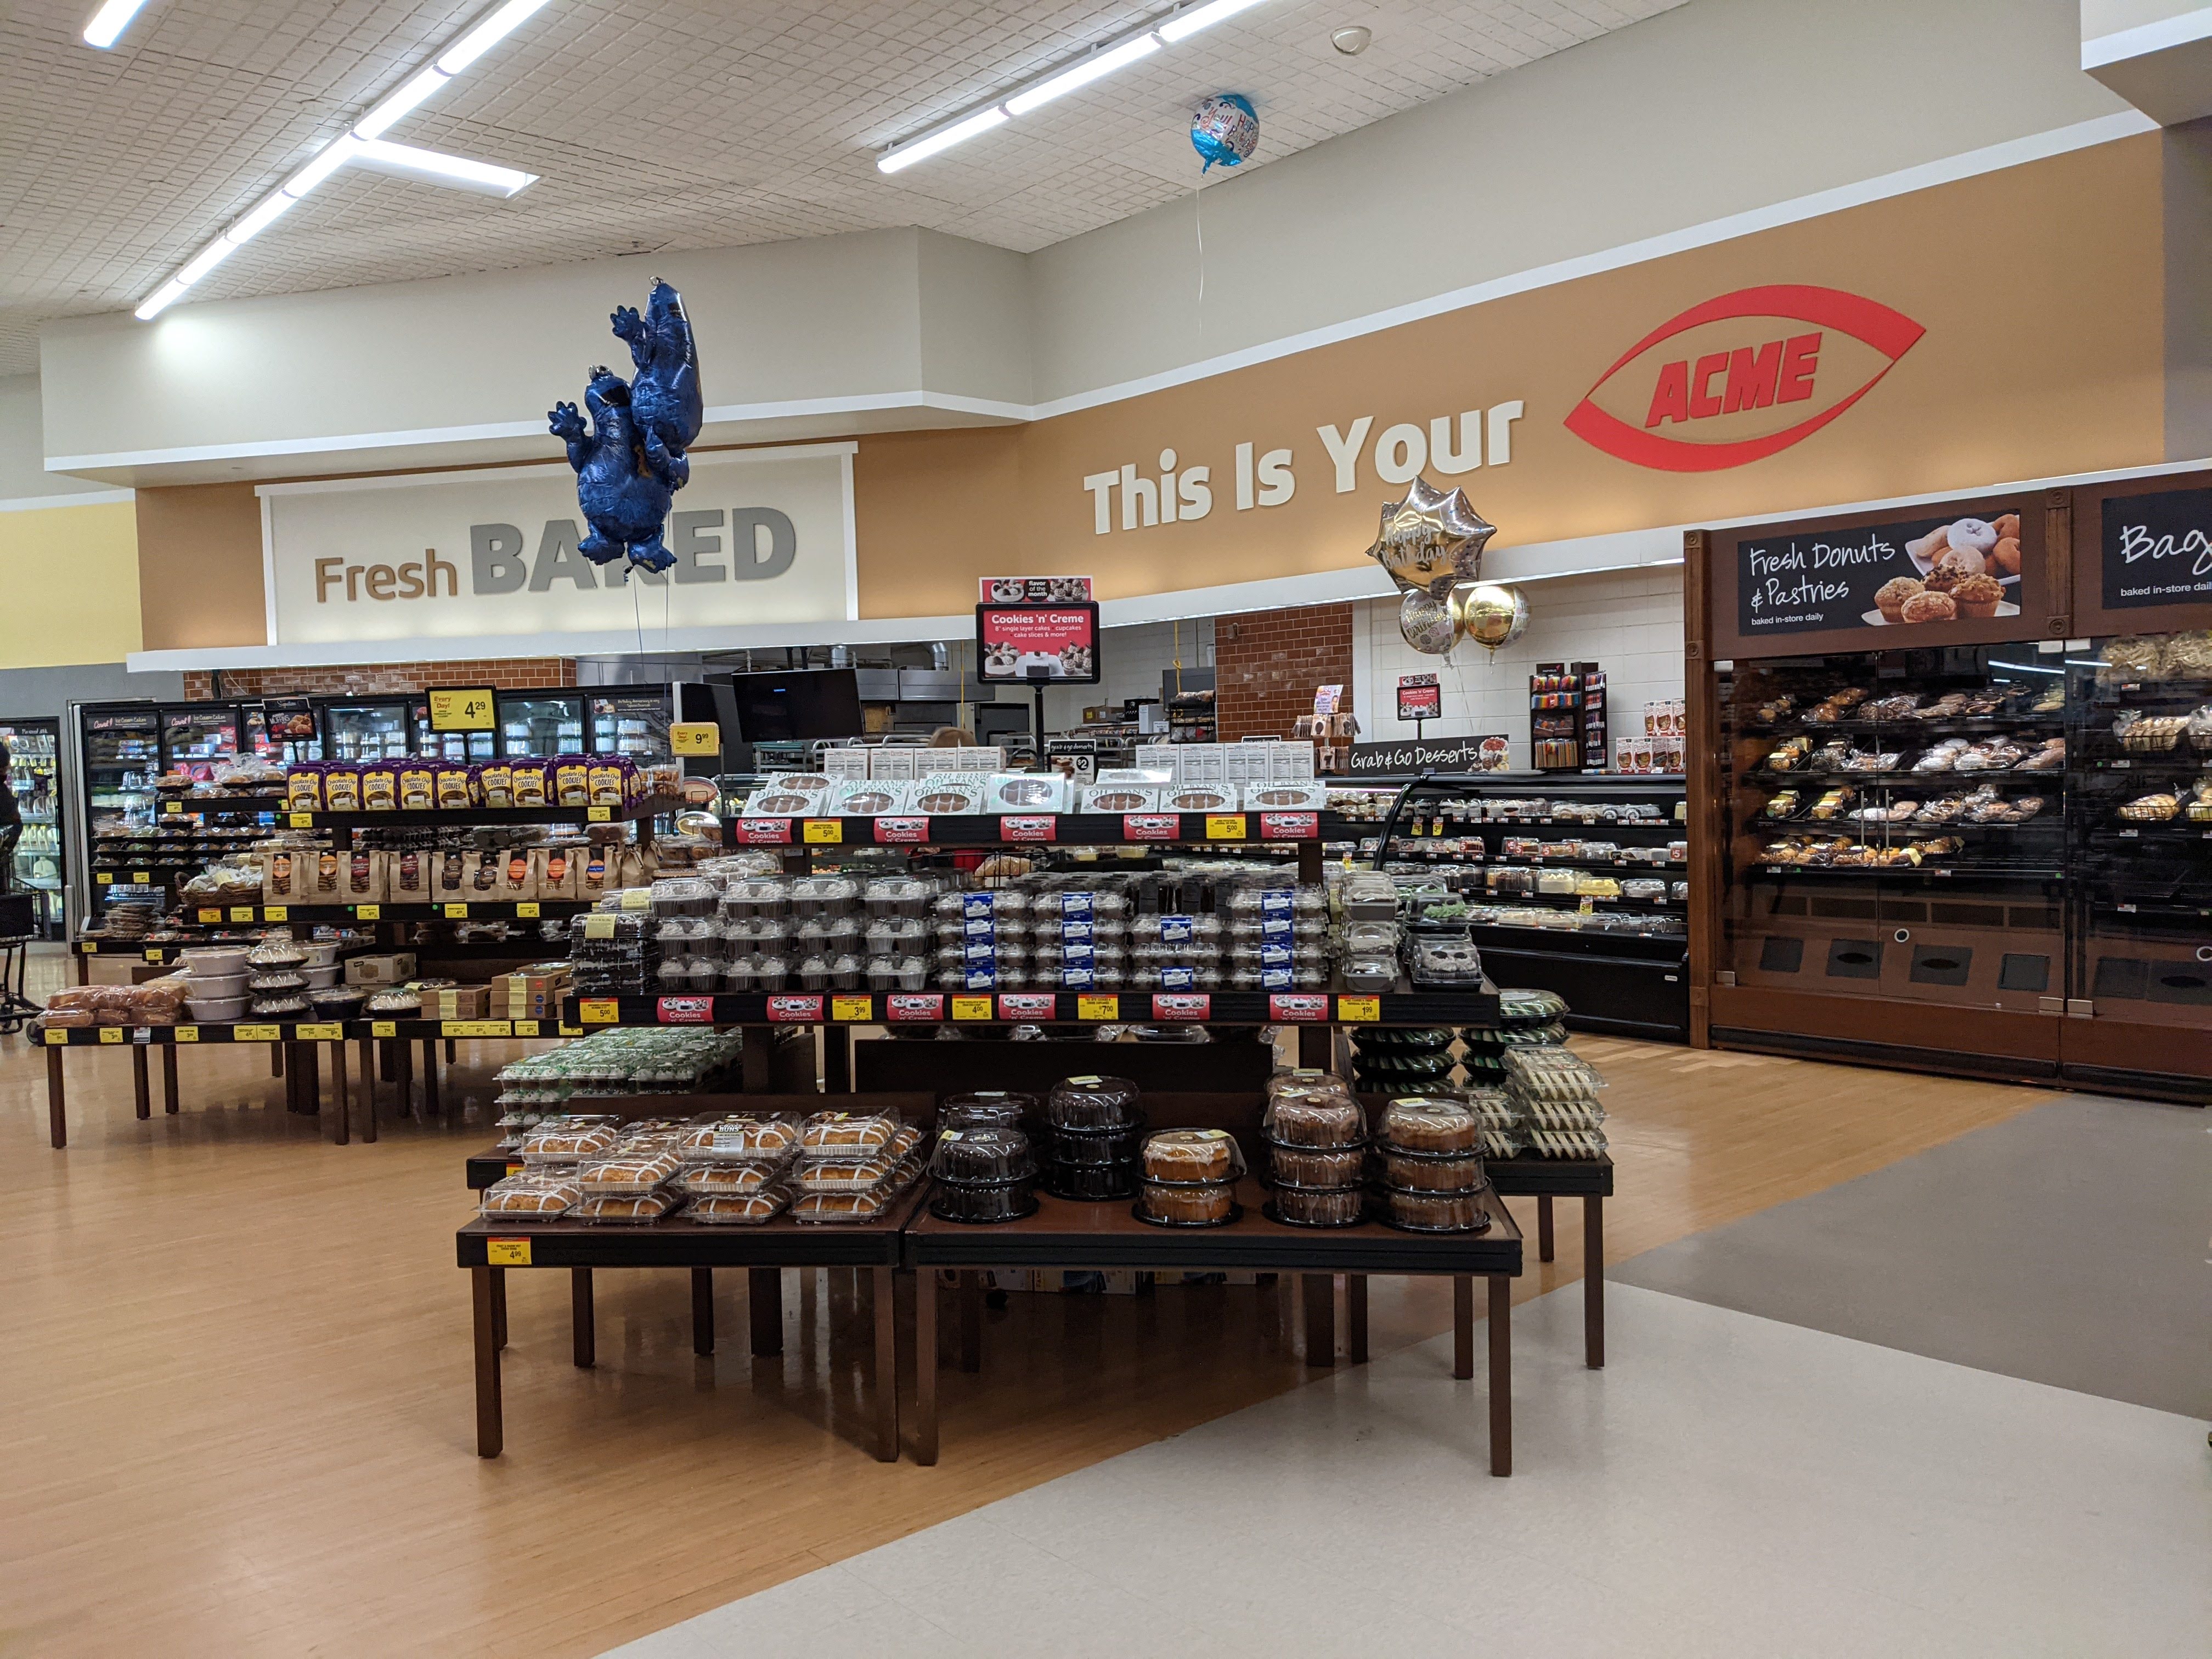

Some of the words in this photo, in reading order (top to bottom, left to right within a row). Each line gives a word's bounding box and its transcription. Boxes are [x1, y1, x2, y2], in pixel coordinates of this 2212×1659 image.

[1645, 332, 1822, 428] ACME
[1084, 448, 1212, 534] This
[1236, 442, 1295, 510] Is
[1316, 400, 1525, 493] Your
[1385, 524, 1432, 546] Happy
[1380, 541, 1447, 569] Birthday
[1750, 542, 1805, 576] Fresh
[1812, 533, 1895, 568] Donuts
[315, 549, 457, 603] Fresh
[1752, 588, 1763, 613] &
[1765, 575, 1849, 606] Pastries
[2121, 586, 2150, 596] baked
[2153, 583, 2191, 594] in-store
[2194, 581, 2212, 591] dail
[991, 614, 1034, 624] Cookies
[1036, 614, 1047, 623] 'n'
[1049, 614, 1084, 623] Creme
[1751, 616, 1774, 625] baked
[1775, 614, 1803, 624] in-store
[1805, 612, 1824, 622] daily
[1351, 751, 1384, 769] Grab
[1394, 749, 1412, 766] Go
[1414, 741, 1477, 765] Desserts
[1077, 759, 1087, 769] $2
[402, 777, 421, 785] Chocolate
[514, 775, 533, 783] Chocolate
[558, 771, 577, 780] Chocolate
[562, 776, 582, 785] COOKIES
[756, 790, 775, 798] OH
[780, 790, 819, 798] RYAN'S
[840, 788, 859, 796] OH
[864, 787, 902, 795] RYAN'S
[939, 789, 978, 797] RYAN'S
